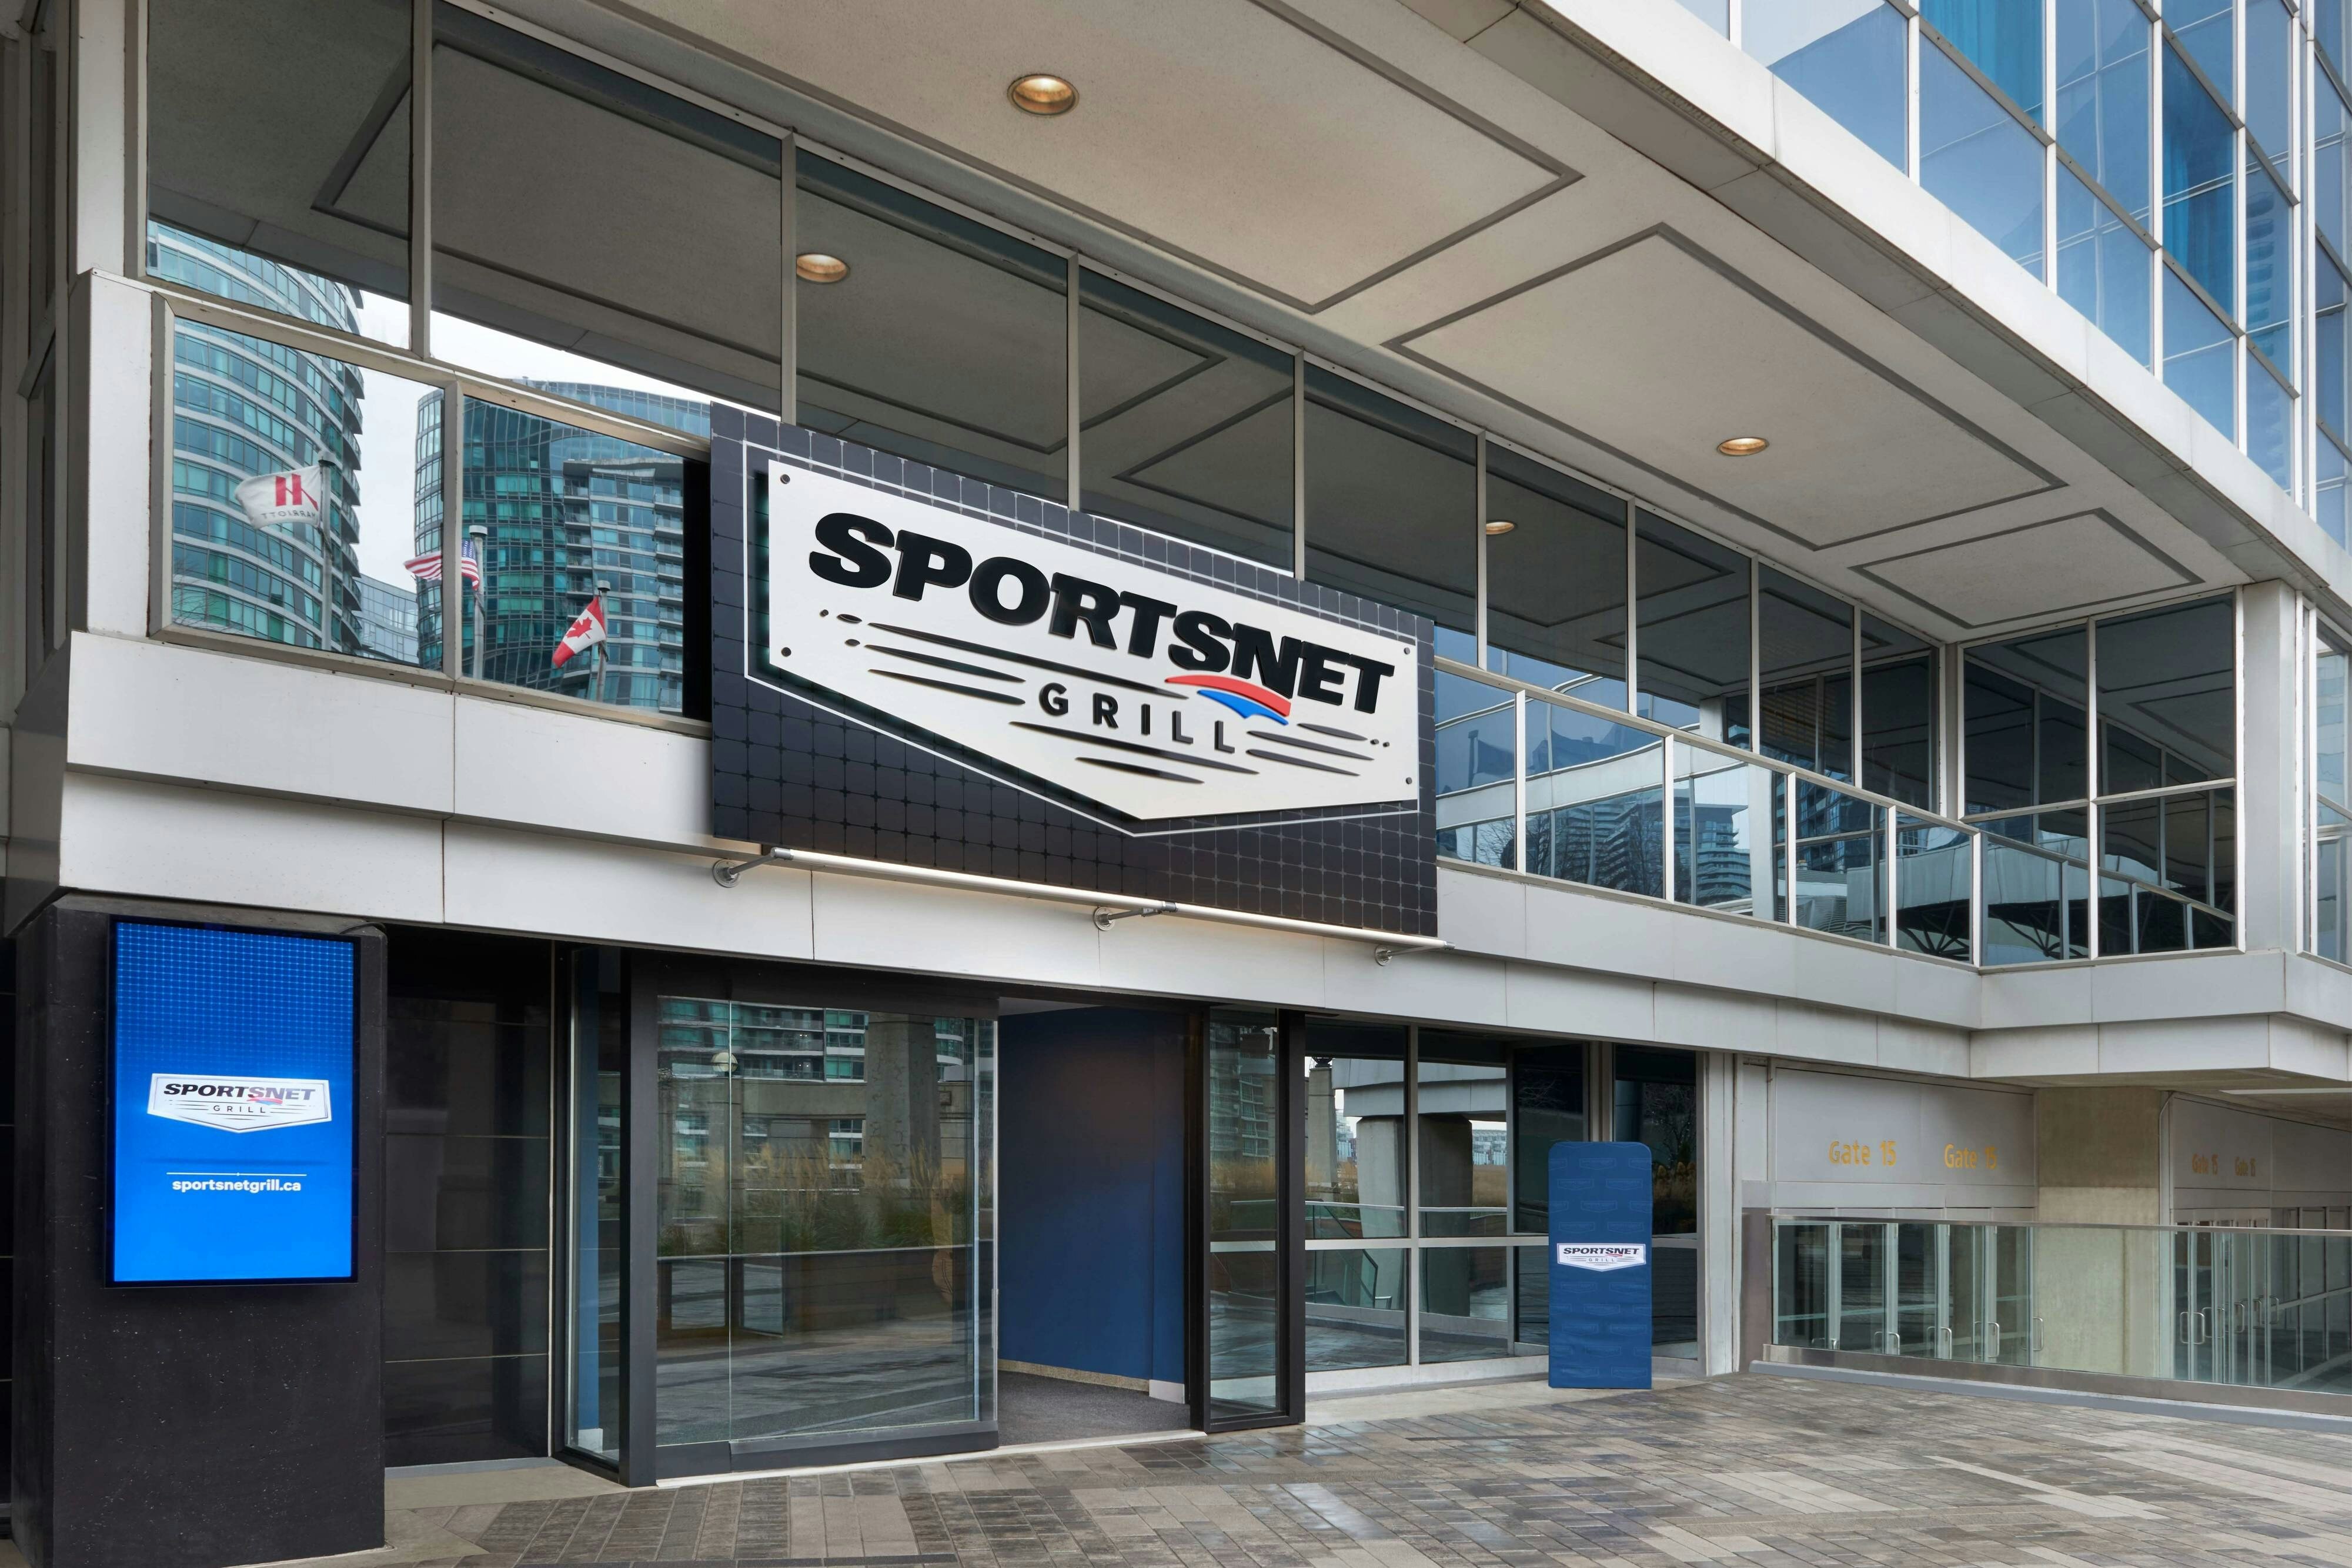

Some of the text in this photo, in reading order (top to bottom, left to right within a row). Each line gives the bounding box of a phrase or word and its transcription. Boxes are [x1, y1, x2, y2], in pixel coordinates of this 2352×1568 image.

[809, 512, 1394, 714] SPORTSNET
[1039, 682, 1235, 754] GRILL
[163, 1083, 315, 1101] SPORTSNET
[213, 1105, 266, 1113] GRILL
[1829, 1141, 1897, 1166] Gate 15
[1944, 1143, 1997, 1169] Gate 15
[172, 1179, 301, 1193] sportsnetgrill.ca
